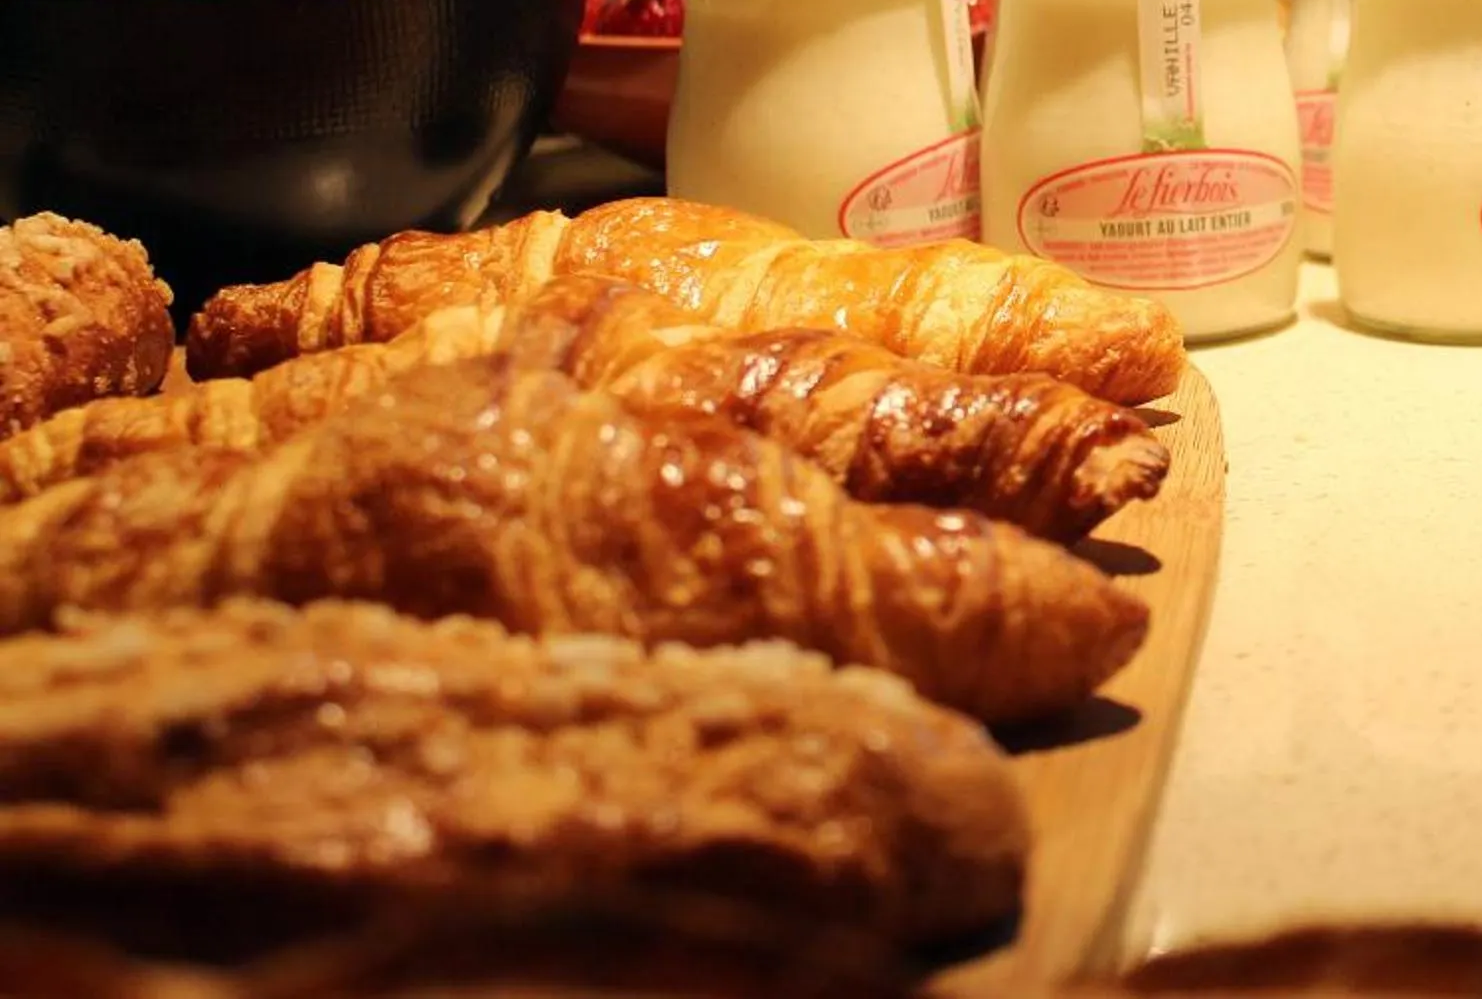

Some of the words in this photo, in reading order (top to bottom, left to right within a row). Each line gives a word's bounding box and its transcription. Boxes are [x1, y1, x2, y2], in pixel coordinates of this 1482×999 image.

[1163, 4, 1181, 98] VANILLE
[1100, 219, 1151, 238] YAOURT
[1157, 218, 1175, 235] AU
[1180, 216, 1206, 234] LAIT
[1211, 211, 1251, 231] ENTIER
